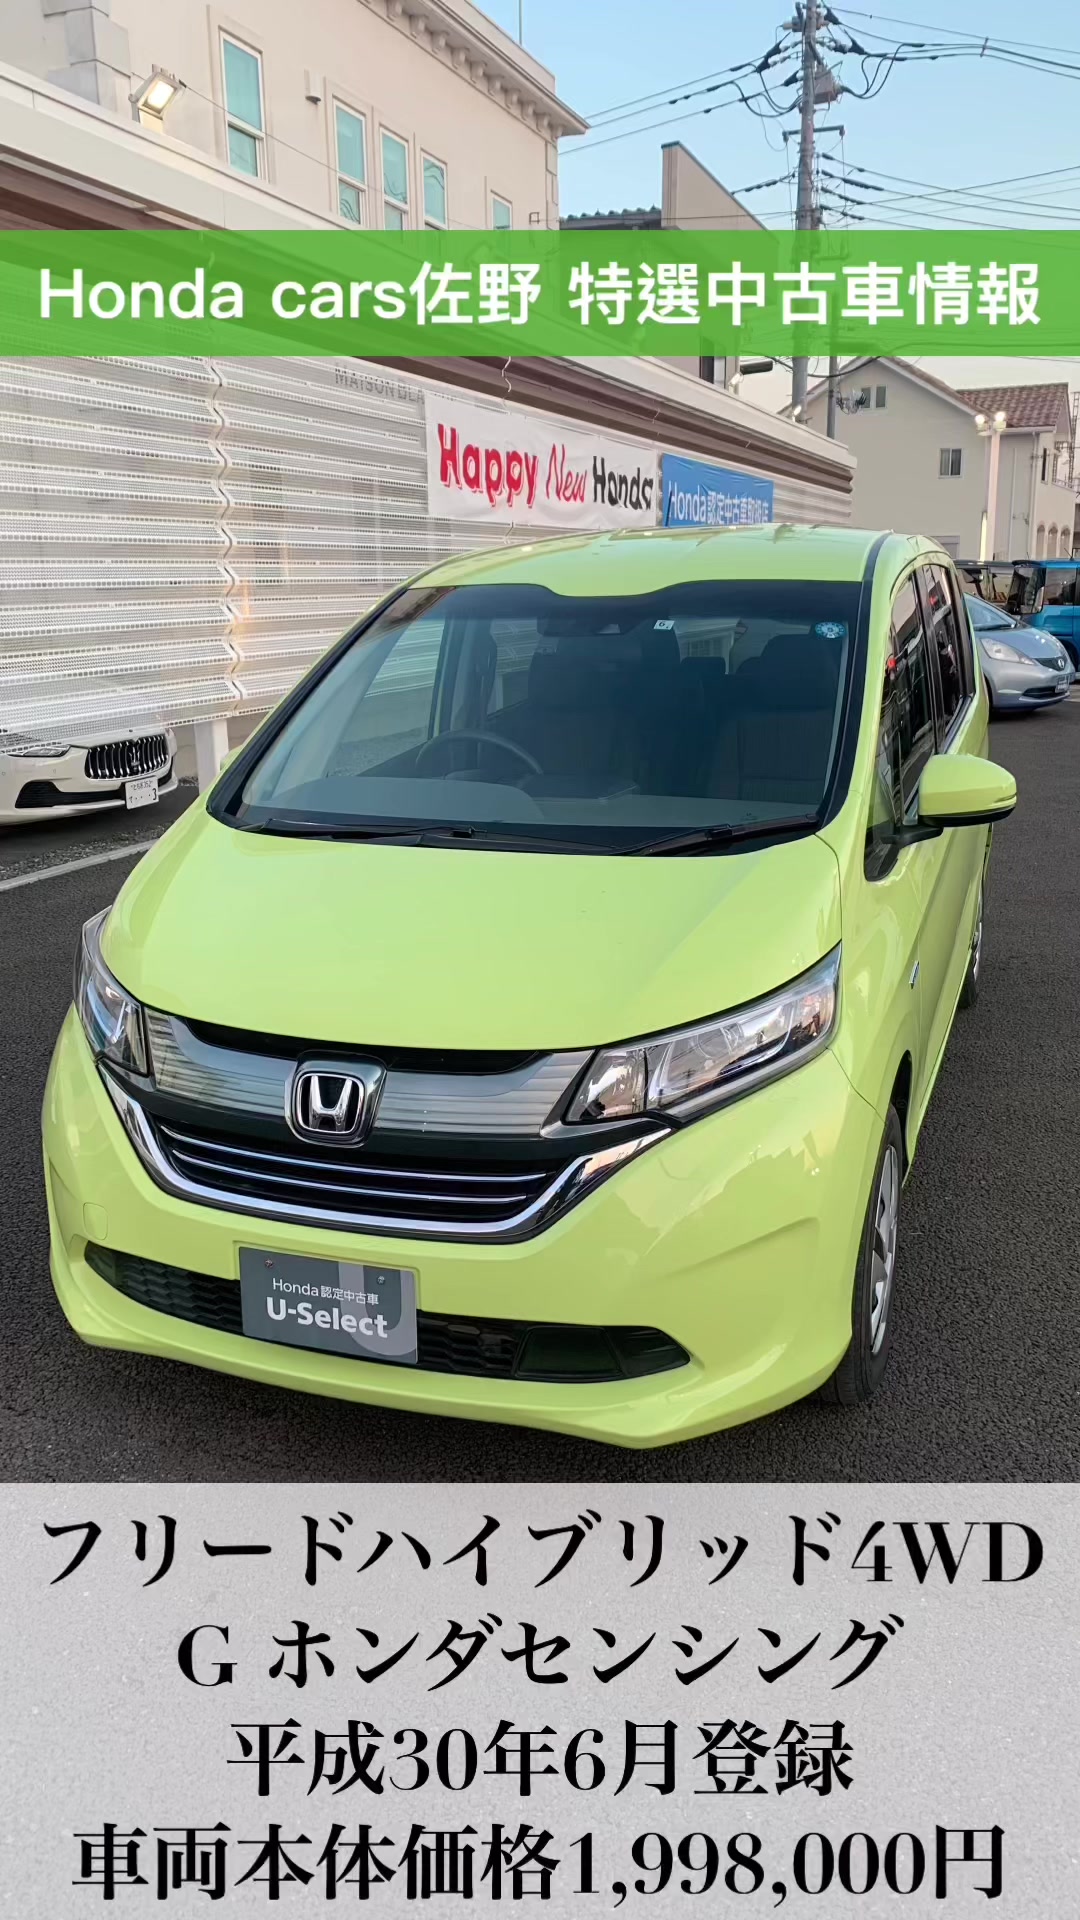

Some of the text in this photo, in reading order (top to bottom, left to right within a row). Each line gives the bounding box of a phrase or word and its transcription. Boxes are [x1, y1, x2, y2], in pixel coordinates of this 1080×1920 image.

[437, 423, 654, 510] Happy New Honda
[272, 1277, 379, 1306] Honda認定中古車
[266, 1296, 388, 1339] U-Select
